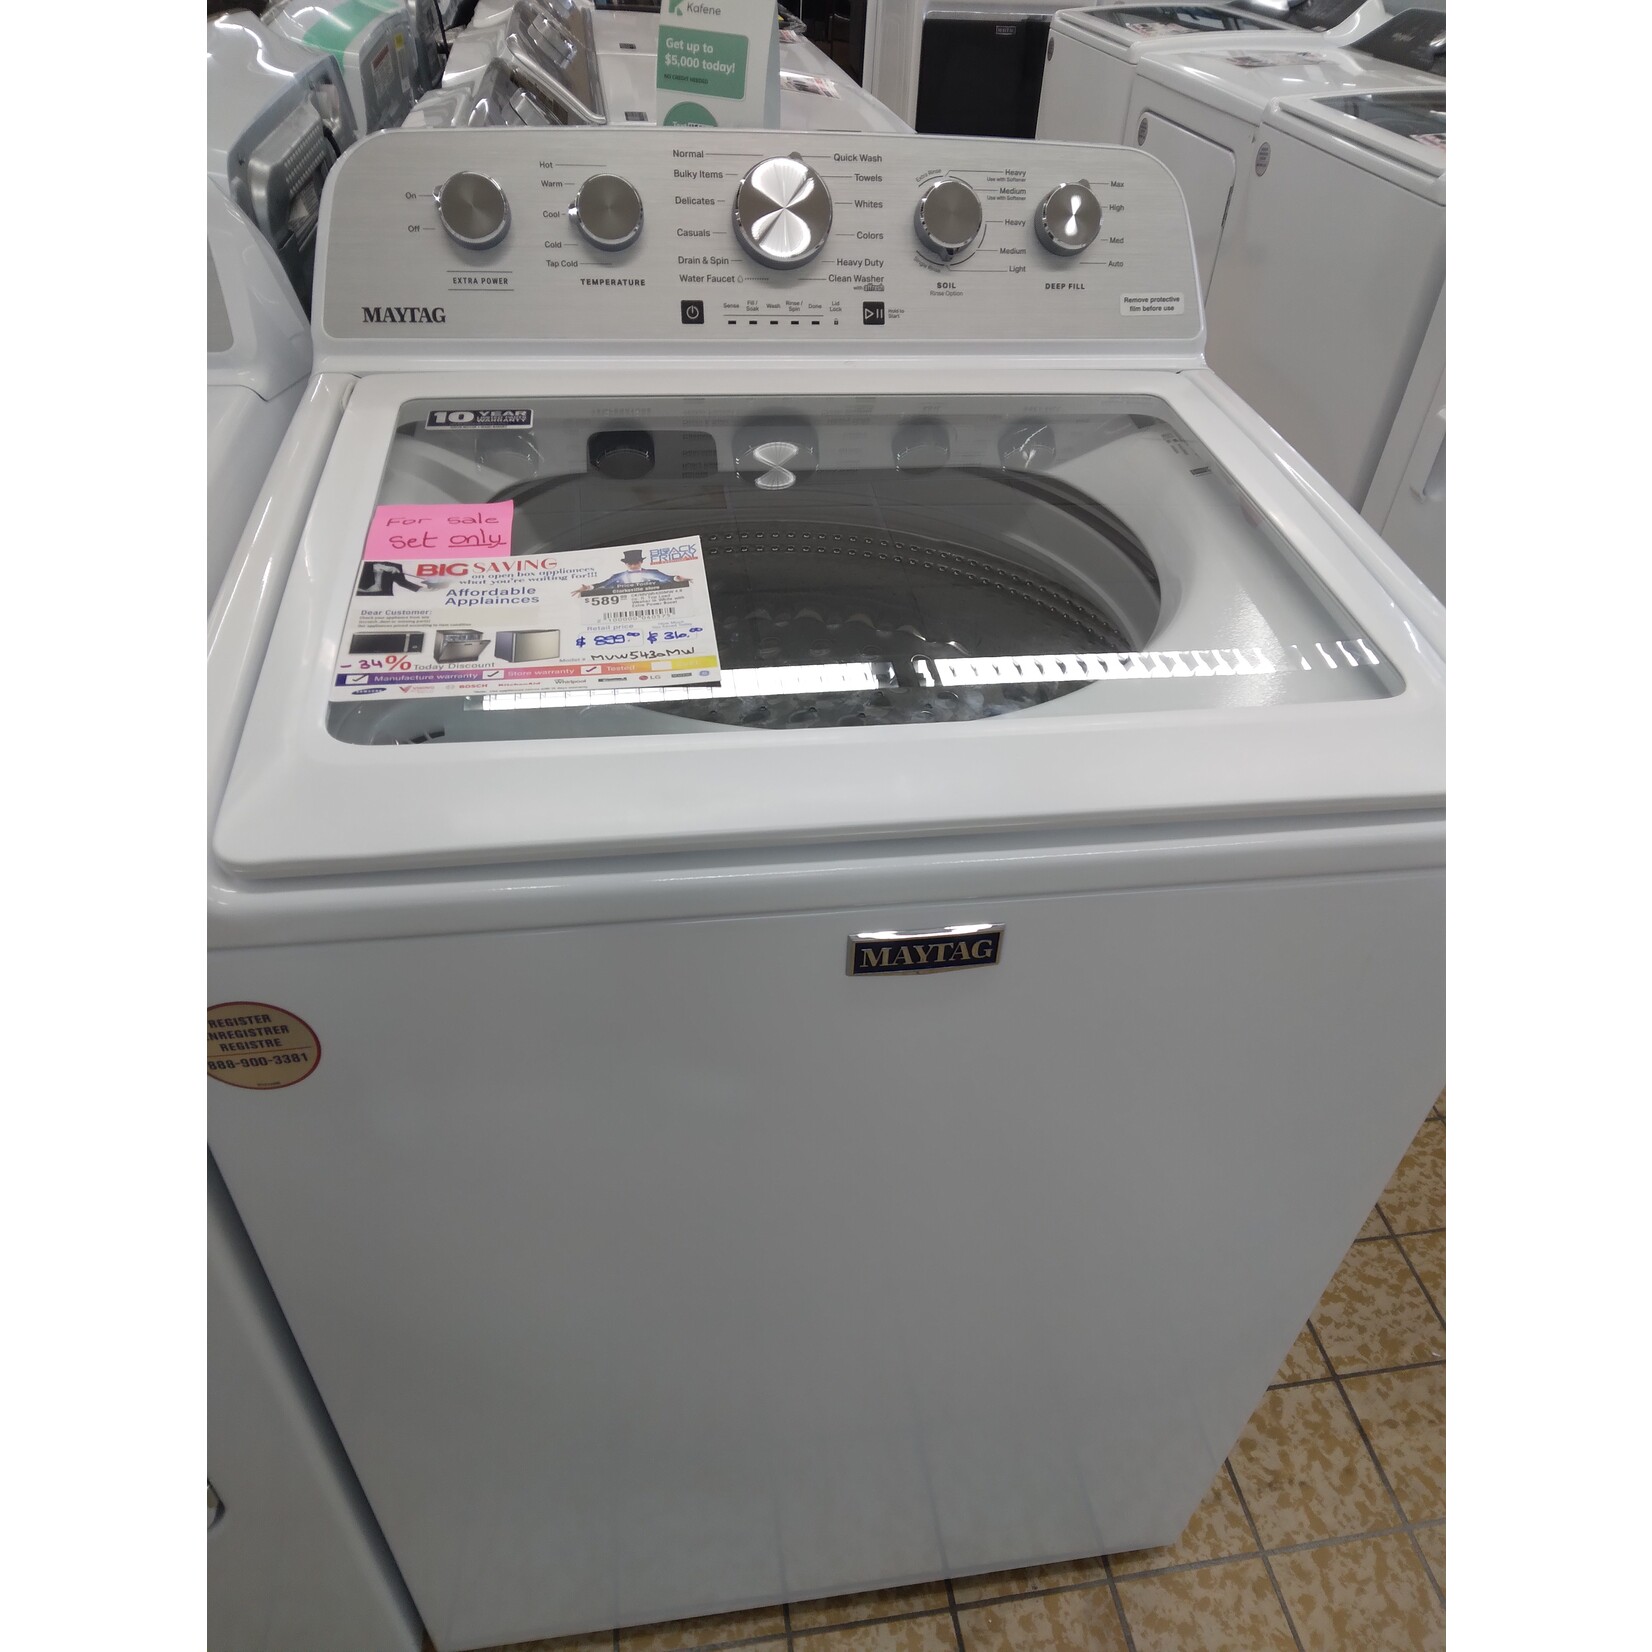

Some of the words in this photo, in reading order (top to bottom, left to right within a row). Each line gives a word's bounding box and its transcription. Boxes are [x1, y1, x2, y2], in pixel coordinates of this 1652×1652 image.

[686, 2, 722, 16] Kafene
[666, 37, 684, 50] Get
[686, 42, 700, 54] up
[702, 43, 714, 54] to
[664, 53, 700, 68] $5,000
[702, 58, 736, 75] today!
[672, 150, 704, 158] Normal
[834, 153, 858, 162] Quick
[859, 154, 882, 162] Wash
[674, 169, 698, 180] Bulky
[700, 170, 724, 178] Items
[1005, 169, 1026, 177] Heavy
[854, 174, 883, 182] Towels
[541, 180, 562, 188] Warm
[675, 196, 715, 205] Delicates
[854, 200, 883, 208] Whites
[1109, 204, 1124, 212] High
[542, 210, 560, 218] Cool
[1005, 219, 1026, 227] Heavy
[677, 228, 711, 237] Casuals
[856, 231, 884, 240] Colors
[547, 260, 559, 268] Tap
[678, 256, 700, 264] Drain
[702, 256, 708, 264] &
[710, 257, 729, 266] Spin
[837, 258, 863, 268] Heavy
[864, 259, 884, 268] Duty
[1107, 260, 1124, 268] Auto
[453, 277, 478, 285] EXTRA
[581, 278, 646, 286] TEMPERATURE
[679, 274, 705, 283] Water
[706, 275, 735, 283] Faucet
[828, 274, 852, 283] Clean
[854, 275, 884, 283] Washer
[945, 290, 964, 298] Option
[1123, 296, 1149, 304] Remove
[1150, 296, 1180, 304] protective
[361, 306, 446, 323] MAYTAG
[434, 412, 474, 424] 10
[386, 517, 432, 527] For
[448, 512, 500, 524] sale
[450, 528, 502, 548] only
[650, 544, 696, 557] BLACK
[650, 552, 695, 563] FRIDAY
[416, 562, 469, 577] BIG
[473, 558, 558, 574] SAVING
[488, 572, 514, 580] open
[539, 566, 595, 576] appliances
[490, 577, 525, 585] you're
[446, 587, 536, 597] Affordable
[445, 596, 540, 607] Applainces
[591, 596, 619, 606] 589
[576, 636, 586, 648] $
[534, 668, 575, 676] warranty
[374, 674, 435, 682] Manufacture
[436, 673, 478, 681] warranty
[860, 940, 992, 968] MAYTAG
[208, 1014, 272, 1028] REGISTER
[207, 1024, 290, 1040] NREGISTRER
[219, 1038, 283, 1052] REGISTRE
[208, 1052, 308, 1070] 888-900-3381
